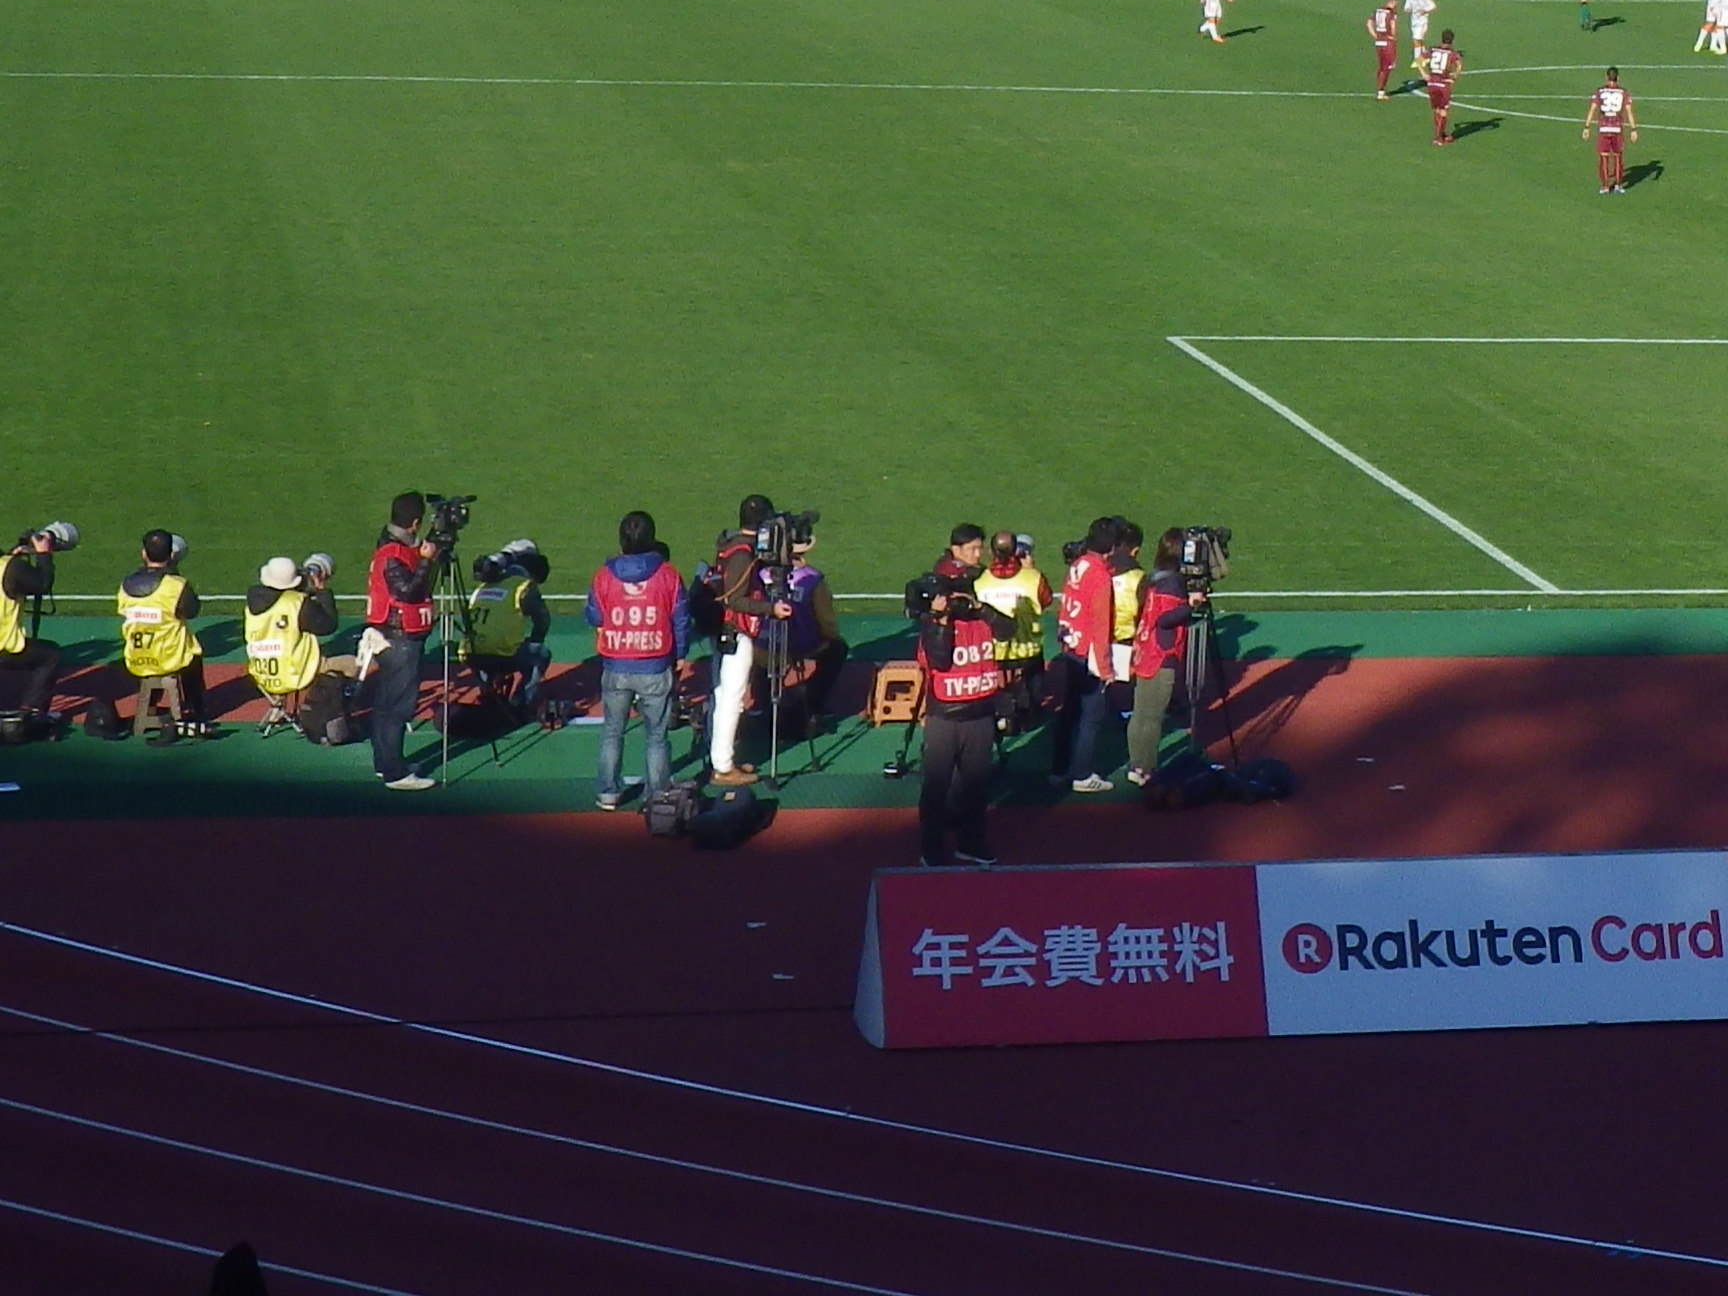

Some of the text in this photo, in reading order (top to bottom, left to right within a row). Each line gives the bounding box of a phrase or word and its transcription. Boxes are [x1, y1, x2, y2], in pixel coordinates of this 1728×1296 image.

[1430, 51, 1448, 71] 21
[1600, 92, 1624, 116] 39
[605, 630, 663, 651] TV-PRESS
[952, 641, 993, 666] 082
[1335, 919, 1584, 971] Rakuten
[1590, 909, 1724, 962] Card
[911, 921, 1235, 990] 年会費無料
